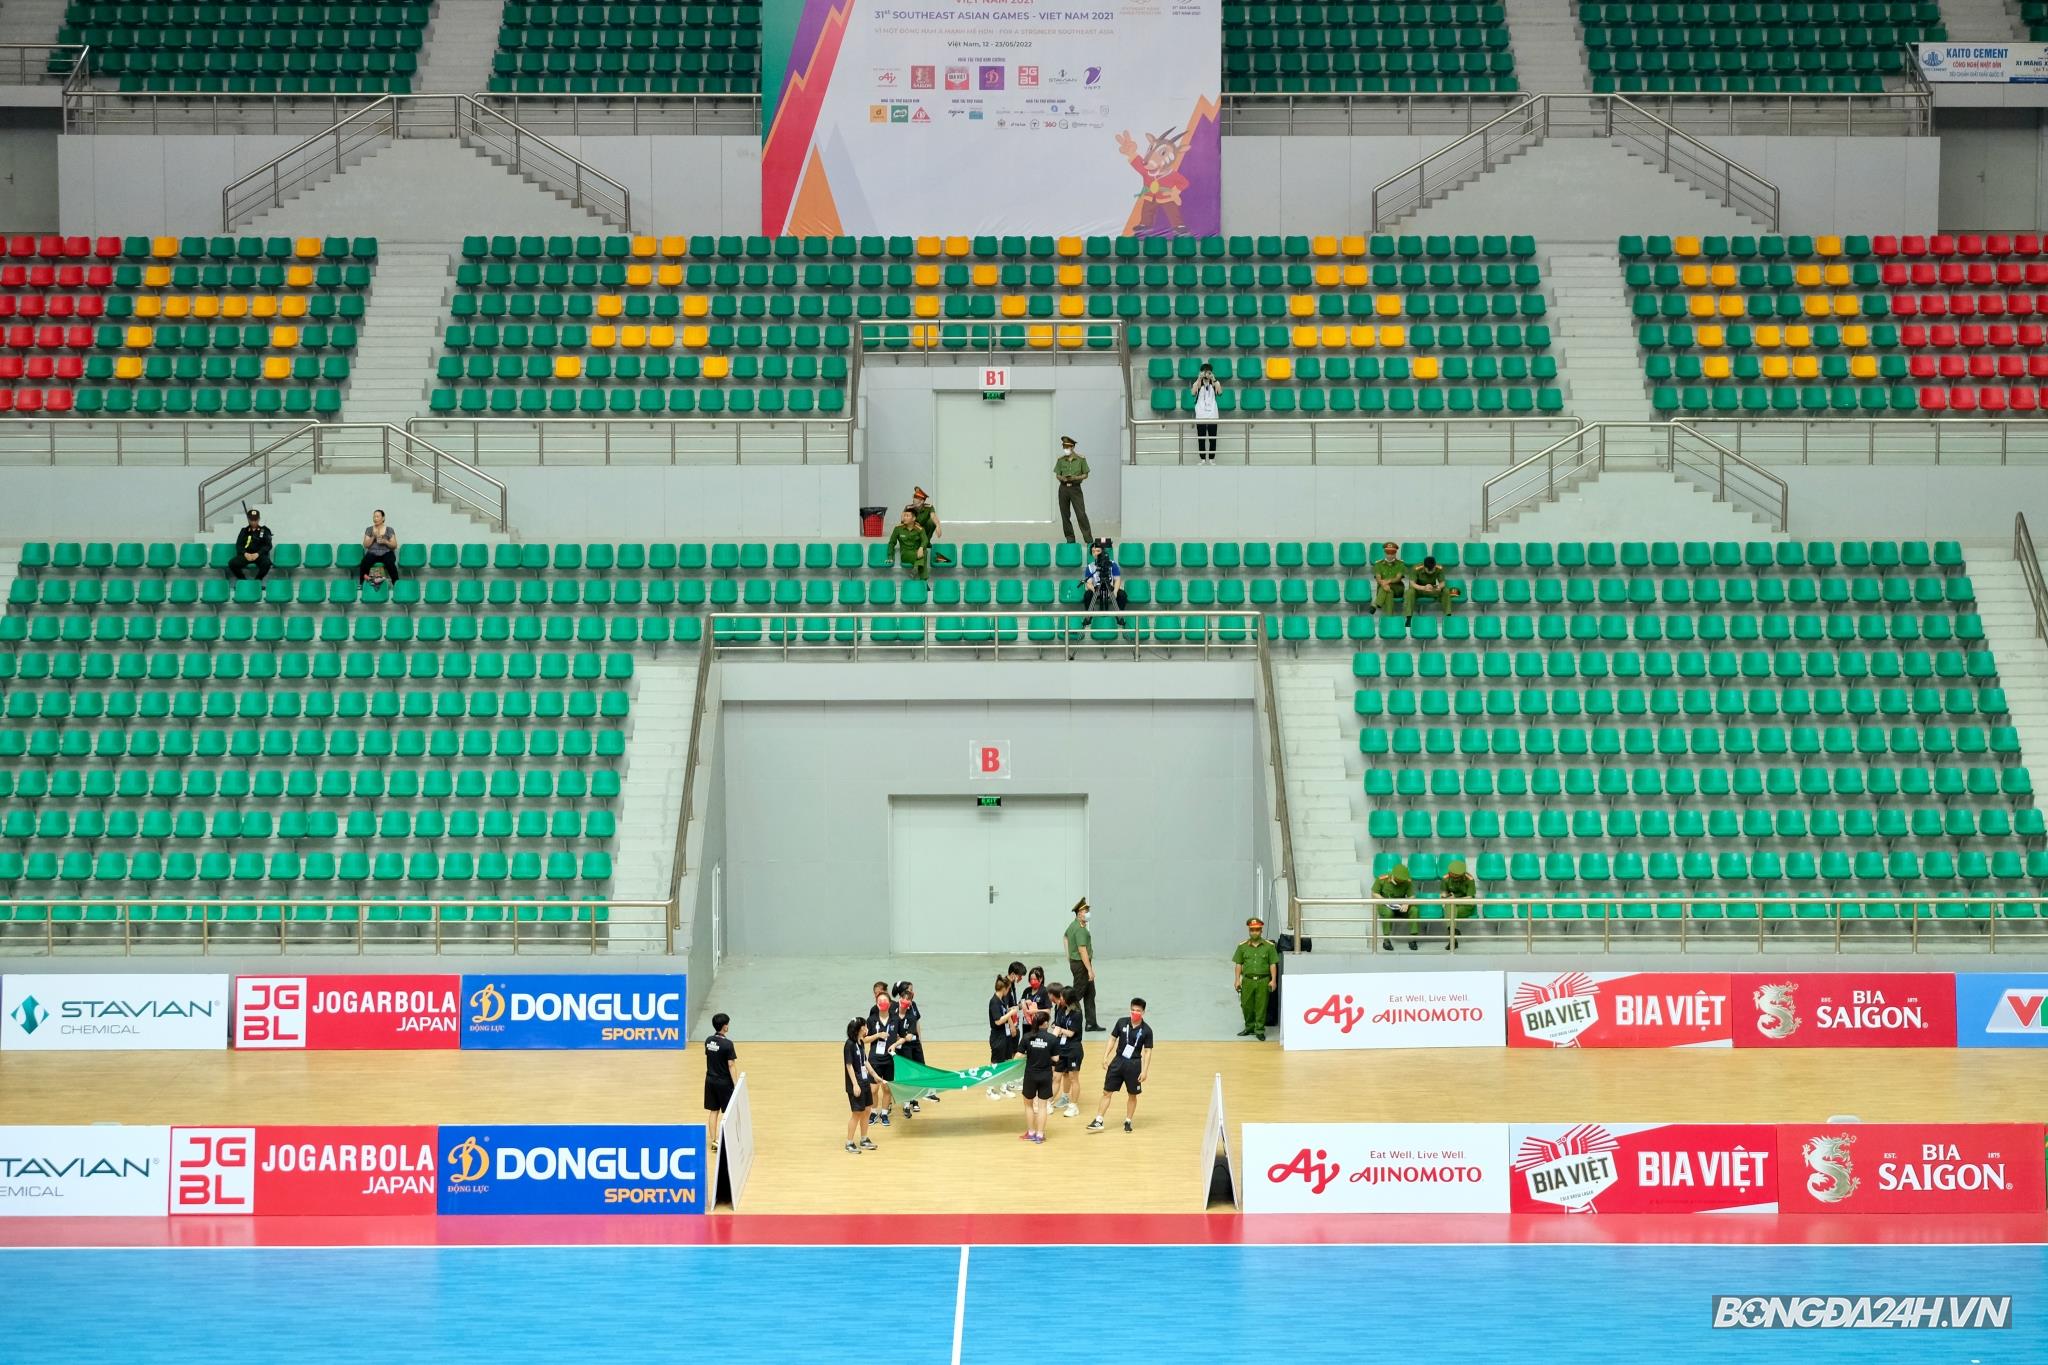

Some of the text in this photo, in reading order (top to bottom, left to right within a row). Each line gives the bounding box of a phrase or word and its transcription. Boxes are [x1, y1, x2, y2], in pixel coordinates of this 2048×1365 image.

[892, 11, 954, 20] SOUTHEAST
[957, 11, 990, 20] ASIAN
[992, 11, 1030, 20] GAMES
[1039, 12, 1062, 20] VIET
[1065, 12, 1089, 20] NAM
[1092, 12, 1114, 20] 2021
[1946, 48, 2008, 58] KAITO CEMENT
[986, 370, 1004, 386] B1
[982, 747, 1000, 772] B
[244, 985, 299, 1010] JG
[312, 991, 456, 1014] JOGARBOLA
[511, 993, 680, 1021] DONGLUC
[1406, 995, 1427, 1003] Well,
[1429, 994, 1446, 1002] Live
[1853, 990, 1886, 1004] BIA
[61, 1000, 212, 1018] STAVIAN
[1304, 994, 1364, 1034] Aj
[1372, 1008, 1484, 1025] AJINOMOTO
[1526, 1000, 1592, 1032] BIA VIỆT
[1616, 990, 1726, 1032] BIA VIỆT
[1816, 1006, 1922, 1029] SAIGON
[60, 1024, 141, 1035] CHEMICAL
[244, 1016, 298, 1040] BL
[396, 1016, 456, 1032] JAPAN
[469, 1024, 505, 1032] ĐỘNG LỰC
[601, 1028, 678, 1041] SPORT.VN
[180, 1137, 246, 1168] JG
[261, 1144, 435, 1172] JOGARBOLA
[1370, 1150, 1386, 1159] Eat
[1389, 1150, 1415, 1160] Well,
[1417, 1150, 1438, 1159] Live
[1922, 1144, 1962, 1160] BIA
[496, 1147, 696, 1180] DONGLUC
[1267, 1148, 1340, 1194] Aj
[1638, 1144, 1769, 1194] BIA VIỆT
[361, 1176, 435, 1194] JAPAN
[1350, 1166, 1482, 1185] AJINOMOTO
[1532, 1156, 1610, 1194] BIA VIỆT
[1878, 1163, 2005, 1191] SAIGON
[179, 1174, 245, 1204] BL
[448, 1184, 490, 1193] ĐỘNG LỰC
[604, 1188, 696, 1203] SPORT.VN
